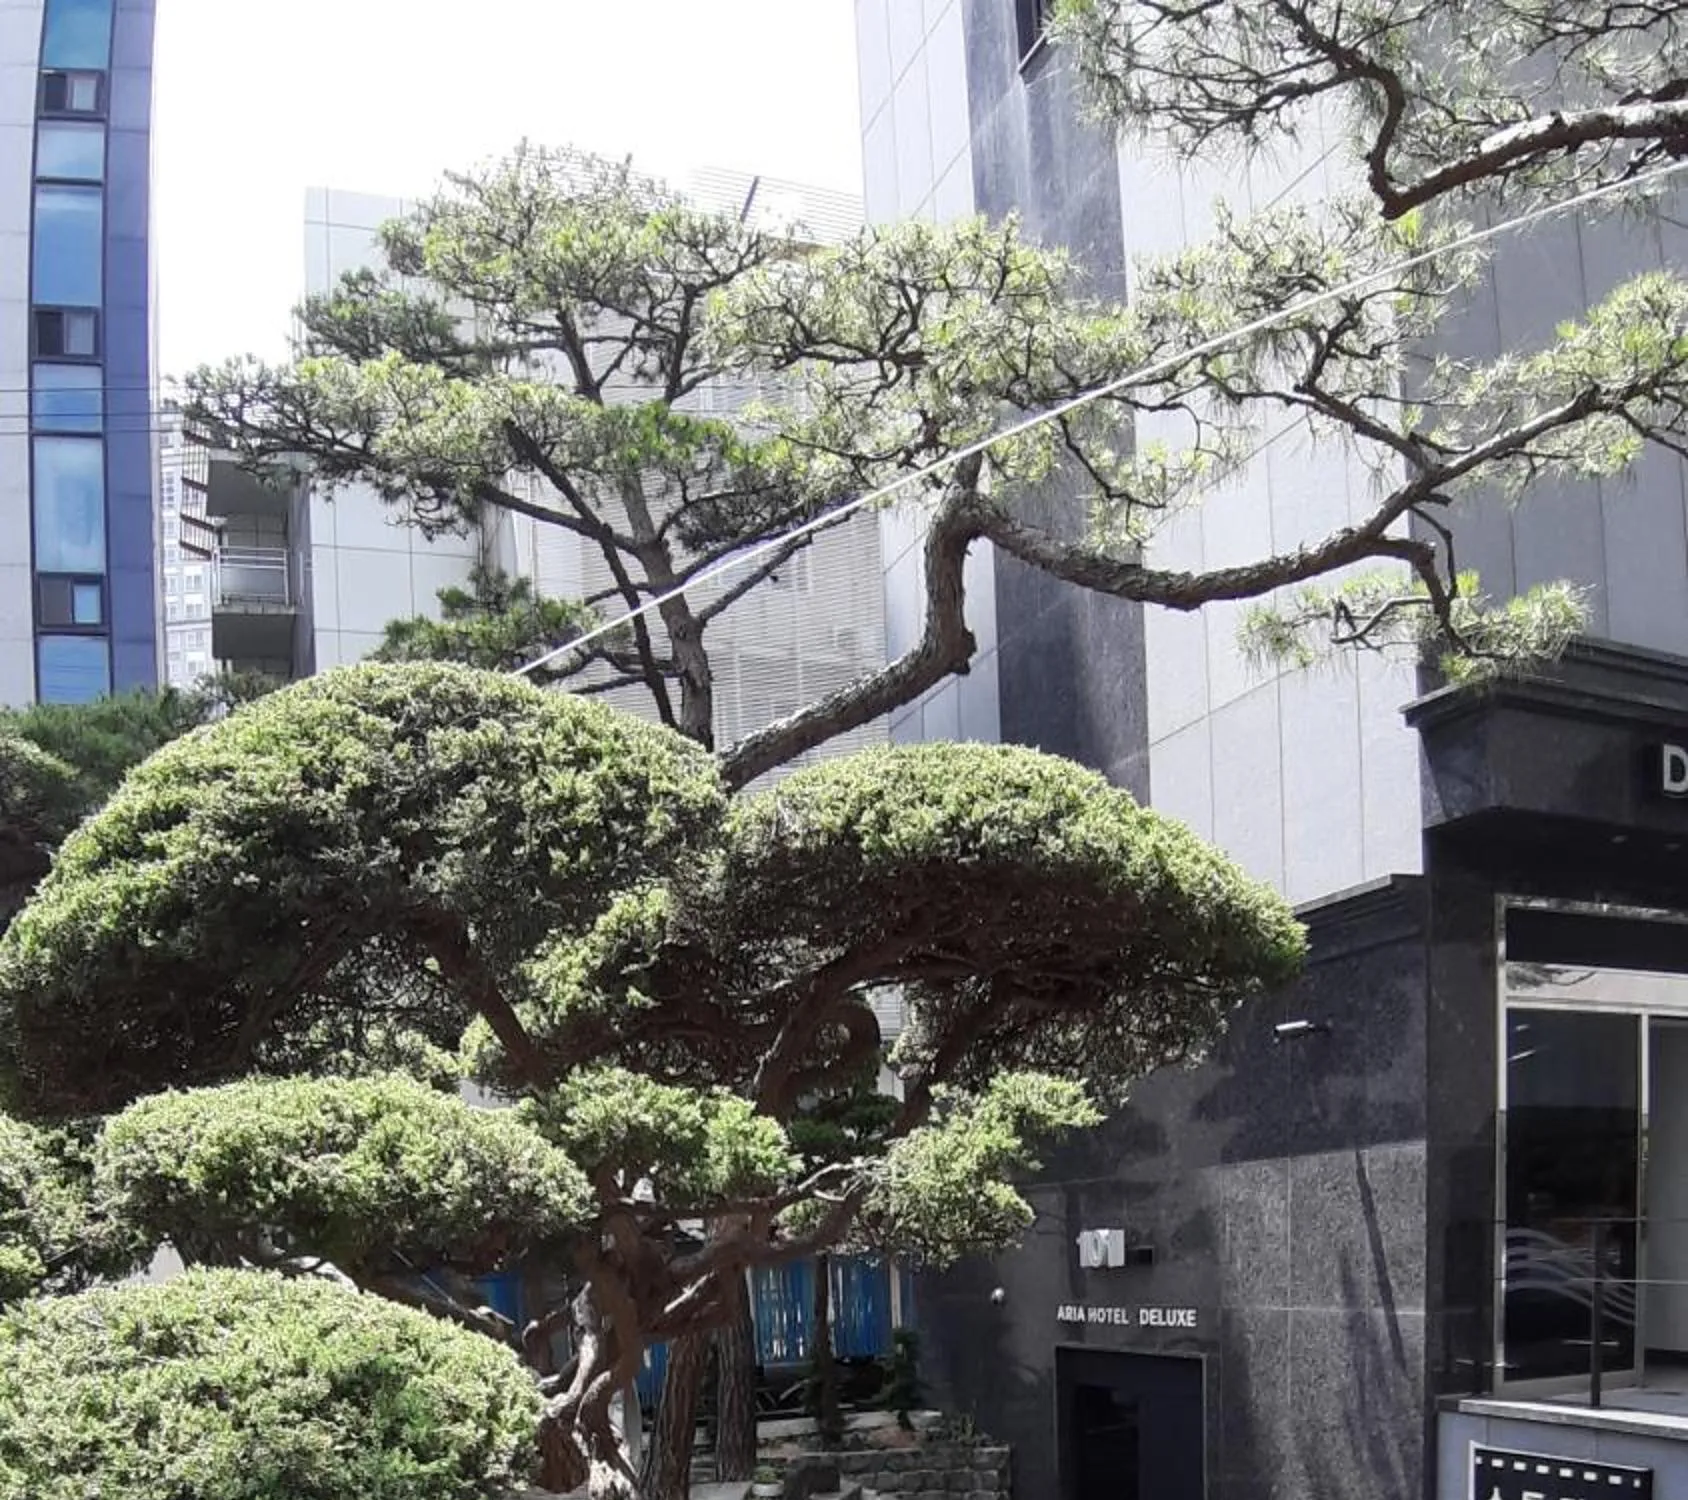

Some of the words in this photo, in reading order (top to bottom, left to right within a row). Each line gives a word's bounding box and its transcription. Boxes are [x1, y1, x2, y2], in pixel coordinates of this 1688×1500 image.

[1057, 1305, 1085, 1322] ARIA
[1087, 1307, 1129, 1325] HOTEL
[1139, 1308, 1197, 1327] DELUXE
